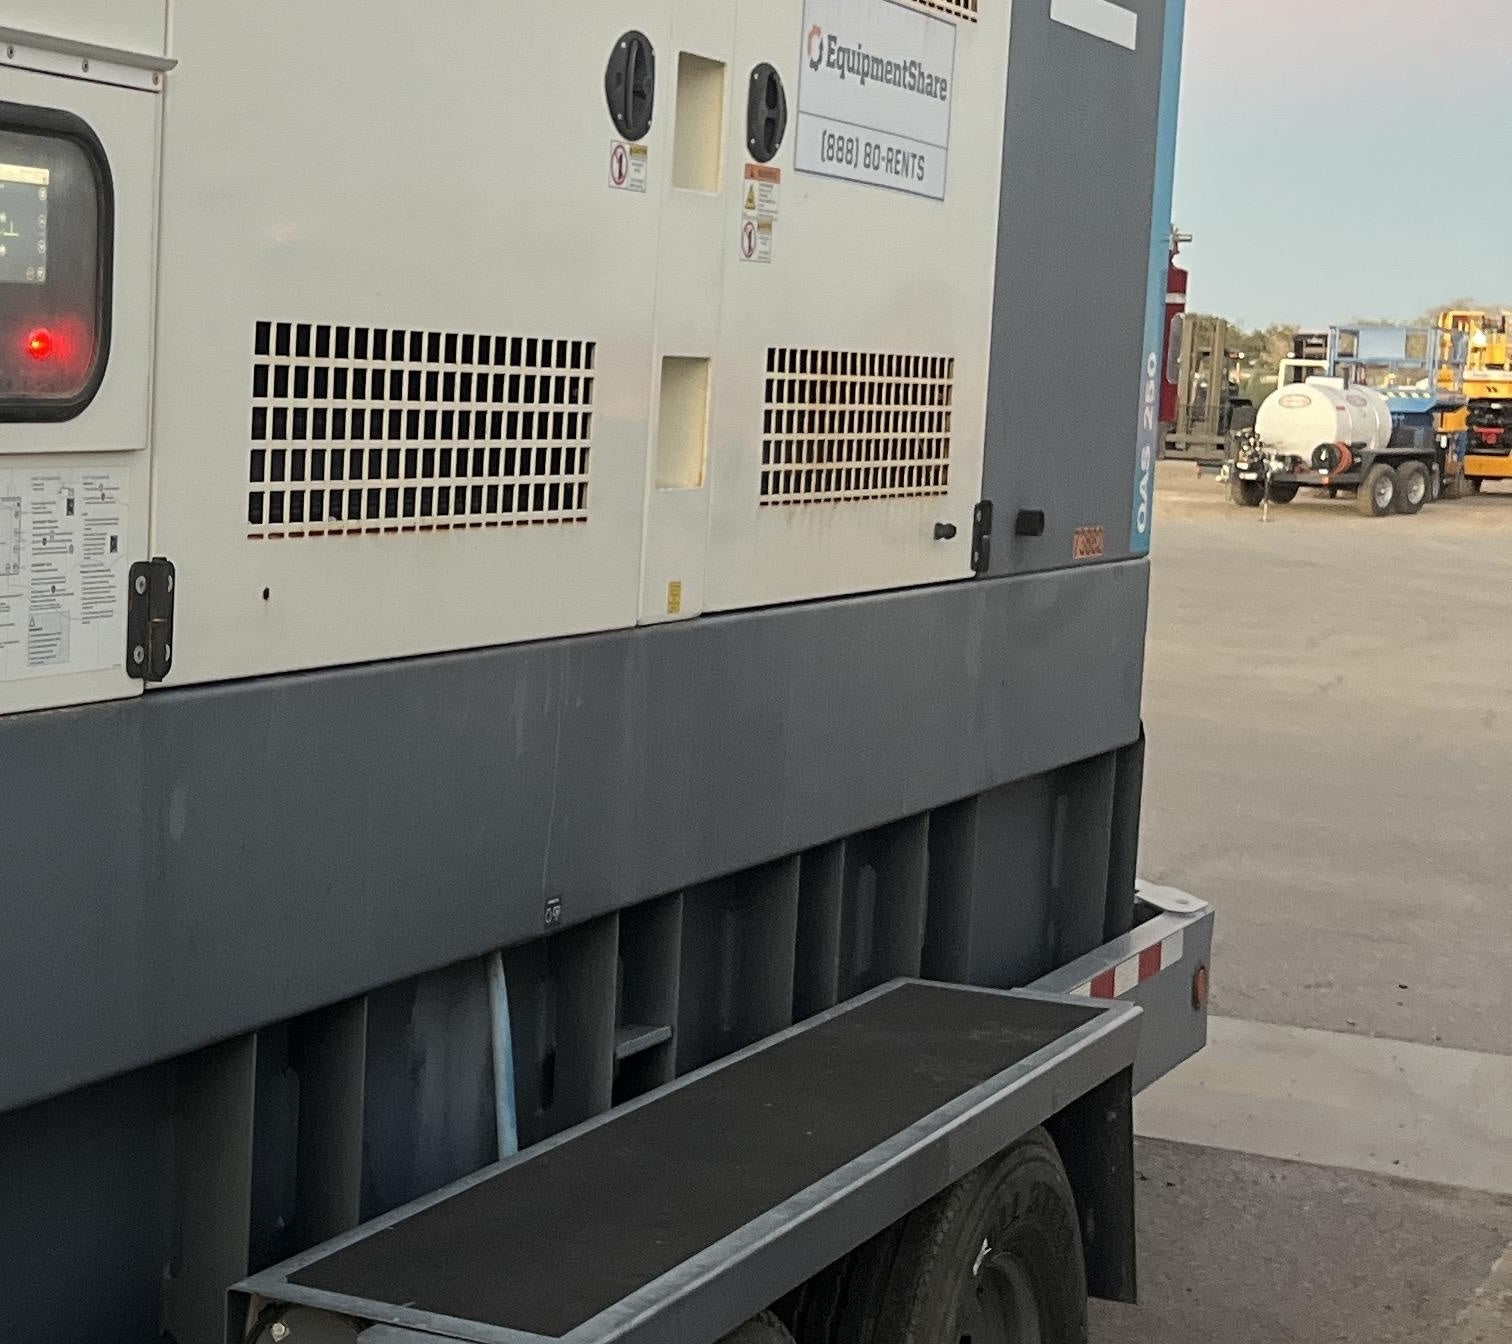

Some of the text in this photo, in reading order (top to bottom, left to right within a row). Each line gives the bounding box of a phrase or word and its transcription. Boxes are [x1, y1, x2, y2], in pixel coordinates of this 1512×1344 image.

[825, 33, 948, 102] EquipmentShare
[820, 129, 926, 182] (888) 80-RENTS
